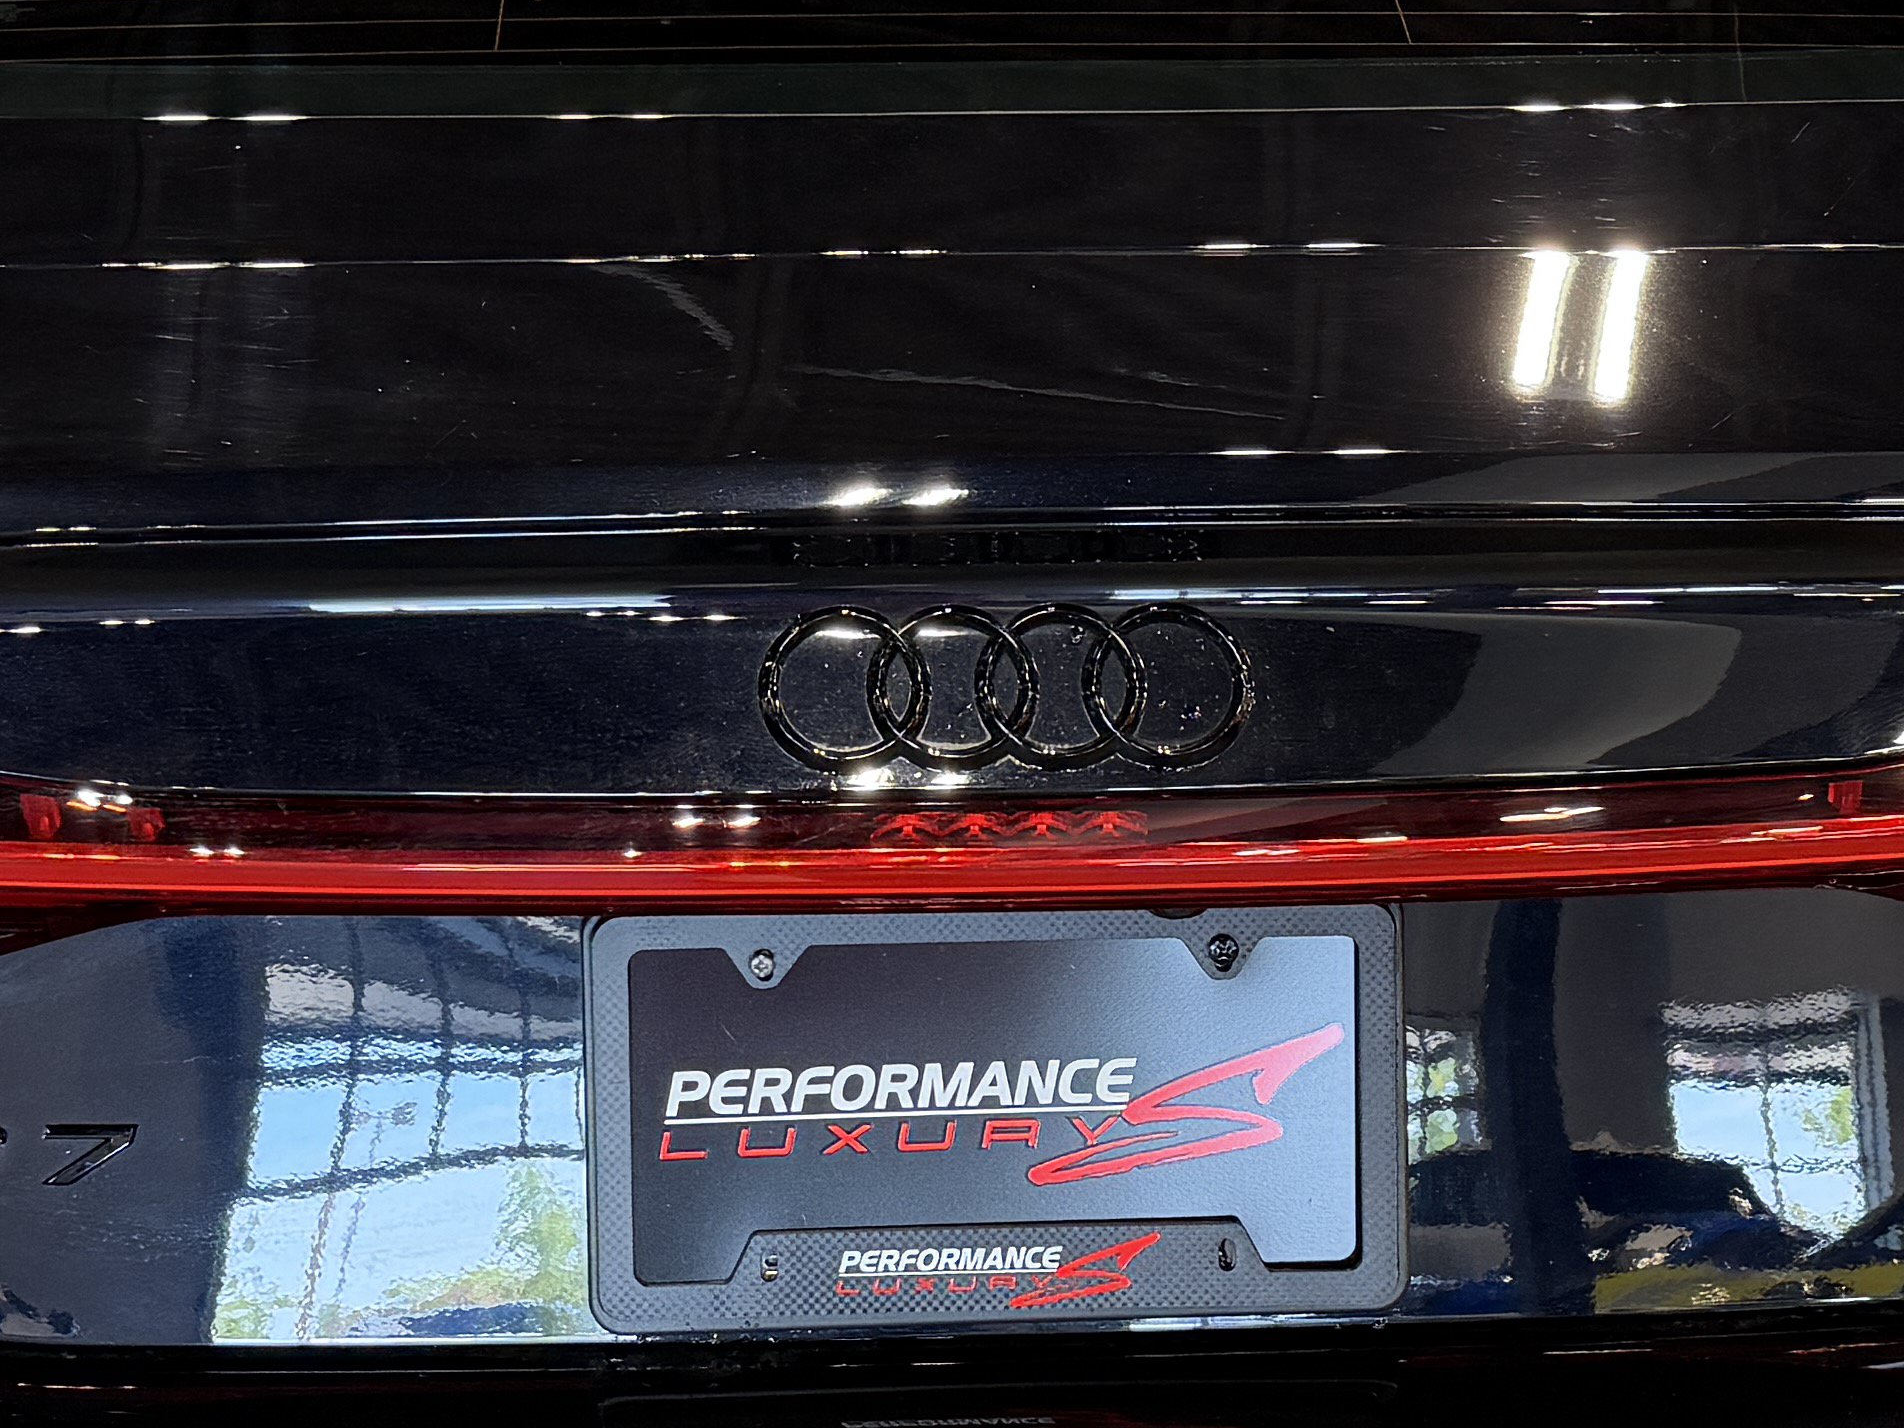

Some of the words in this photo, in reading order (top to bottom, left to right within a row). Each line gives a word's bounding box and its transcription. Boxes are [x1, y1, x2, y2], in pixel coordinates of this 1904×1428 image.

[665, 1057, 1138, 1117] PERFORMANCE
[41, 1123, 140, 1186] 7
[659, 1110, 1123, 1161] LUXURY
[839, 1245, 1063, 1272] PERFORMANCE
[835, 1274, 1053, 1296] LUXURY
